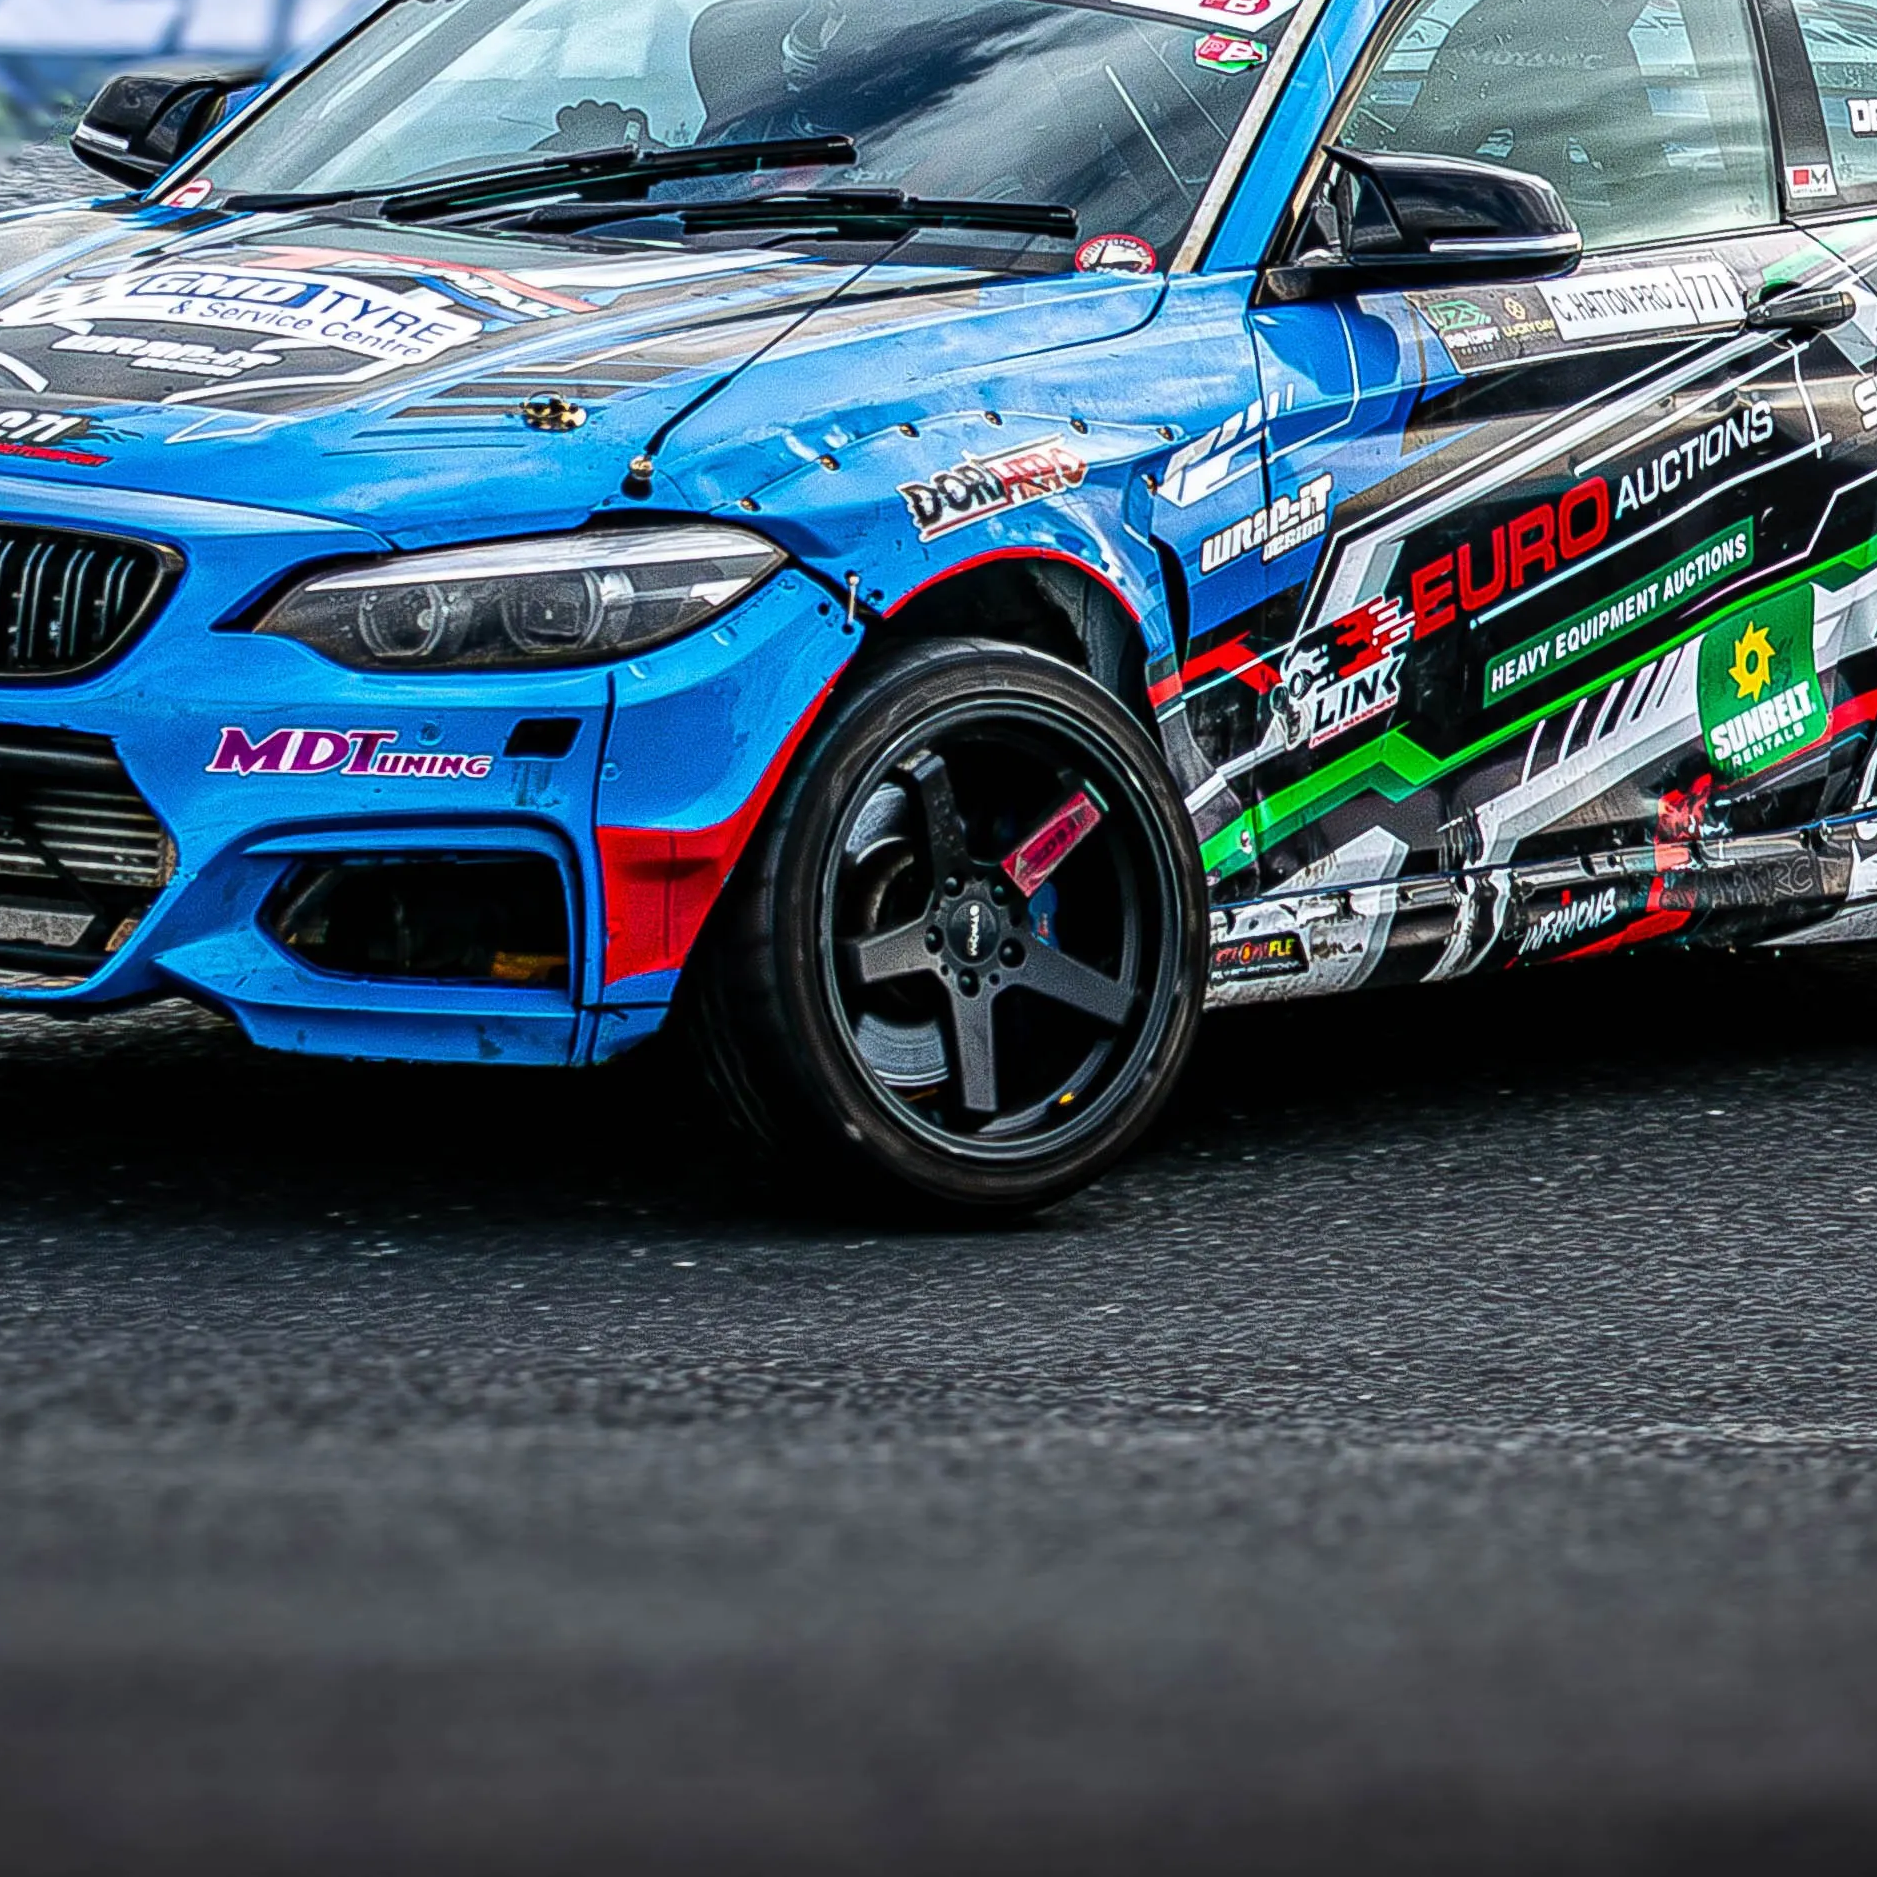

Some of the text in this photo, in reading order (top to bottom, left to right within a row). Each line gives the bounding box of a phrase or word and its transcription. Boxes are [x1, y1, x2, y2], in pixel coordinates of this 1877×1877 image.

[316, 290, 459, 344] TYRE
[1572, 286, 1638, 321] HATTON
[1637, 283, 1672, 313] PRO
[1683, 274, 1735, 311] 771
[168, 300, 424, 357] & Service Centre
[1412, 400, 1775, 639] EURO AUCTIONS
[1491, 532, 1748, 691] HEAVY EQUIPMENT AUCTIONS
[1311, 656, 1406, 735] LINK
[1710, 684, 1815, 761] SUNBELT
[1730, 722, 1806, 768] RENTALS
